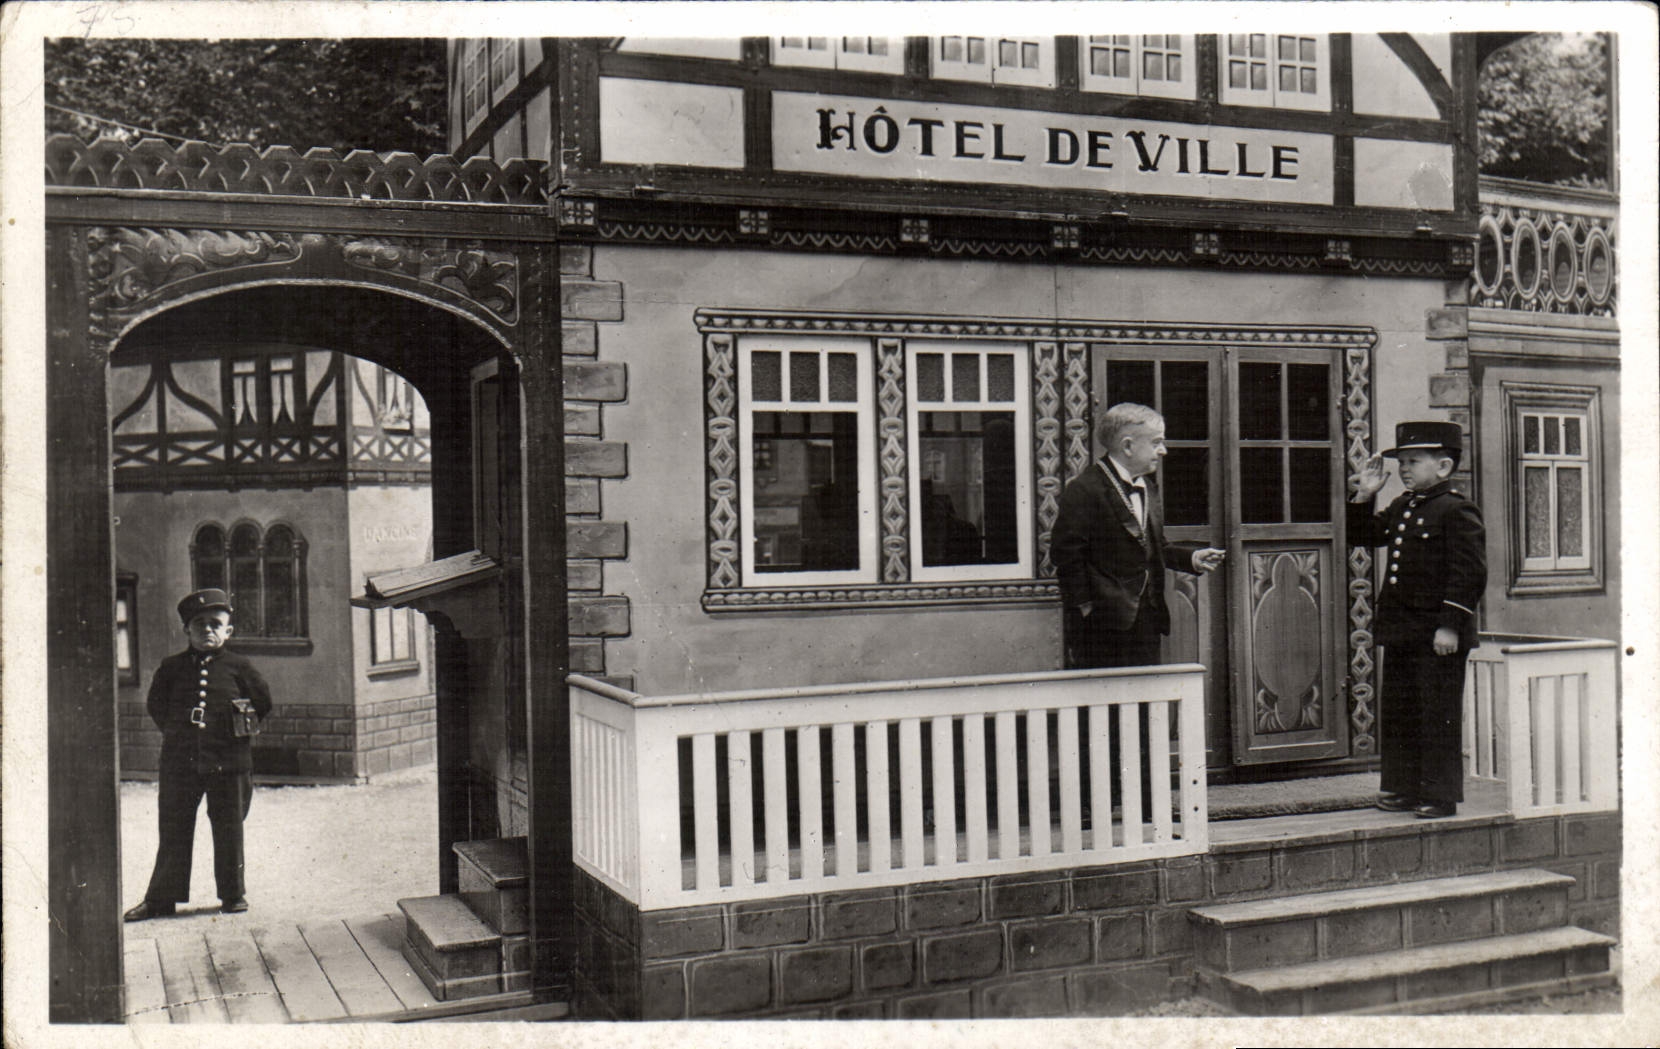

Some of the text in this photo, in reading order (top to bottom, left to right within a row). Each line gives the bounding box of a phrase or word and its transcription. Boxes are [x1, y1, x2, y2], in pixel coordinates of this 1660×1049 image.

[815, 106, 1300, 180] HÔTEL DE VILLE
